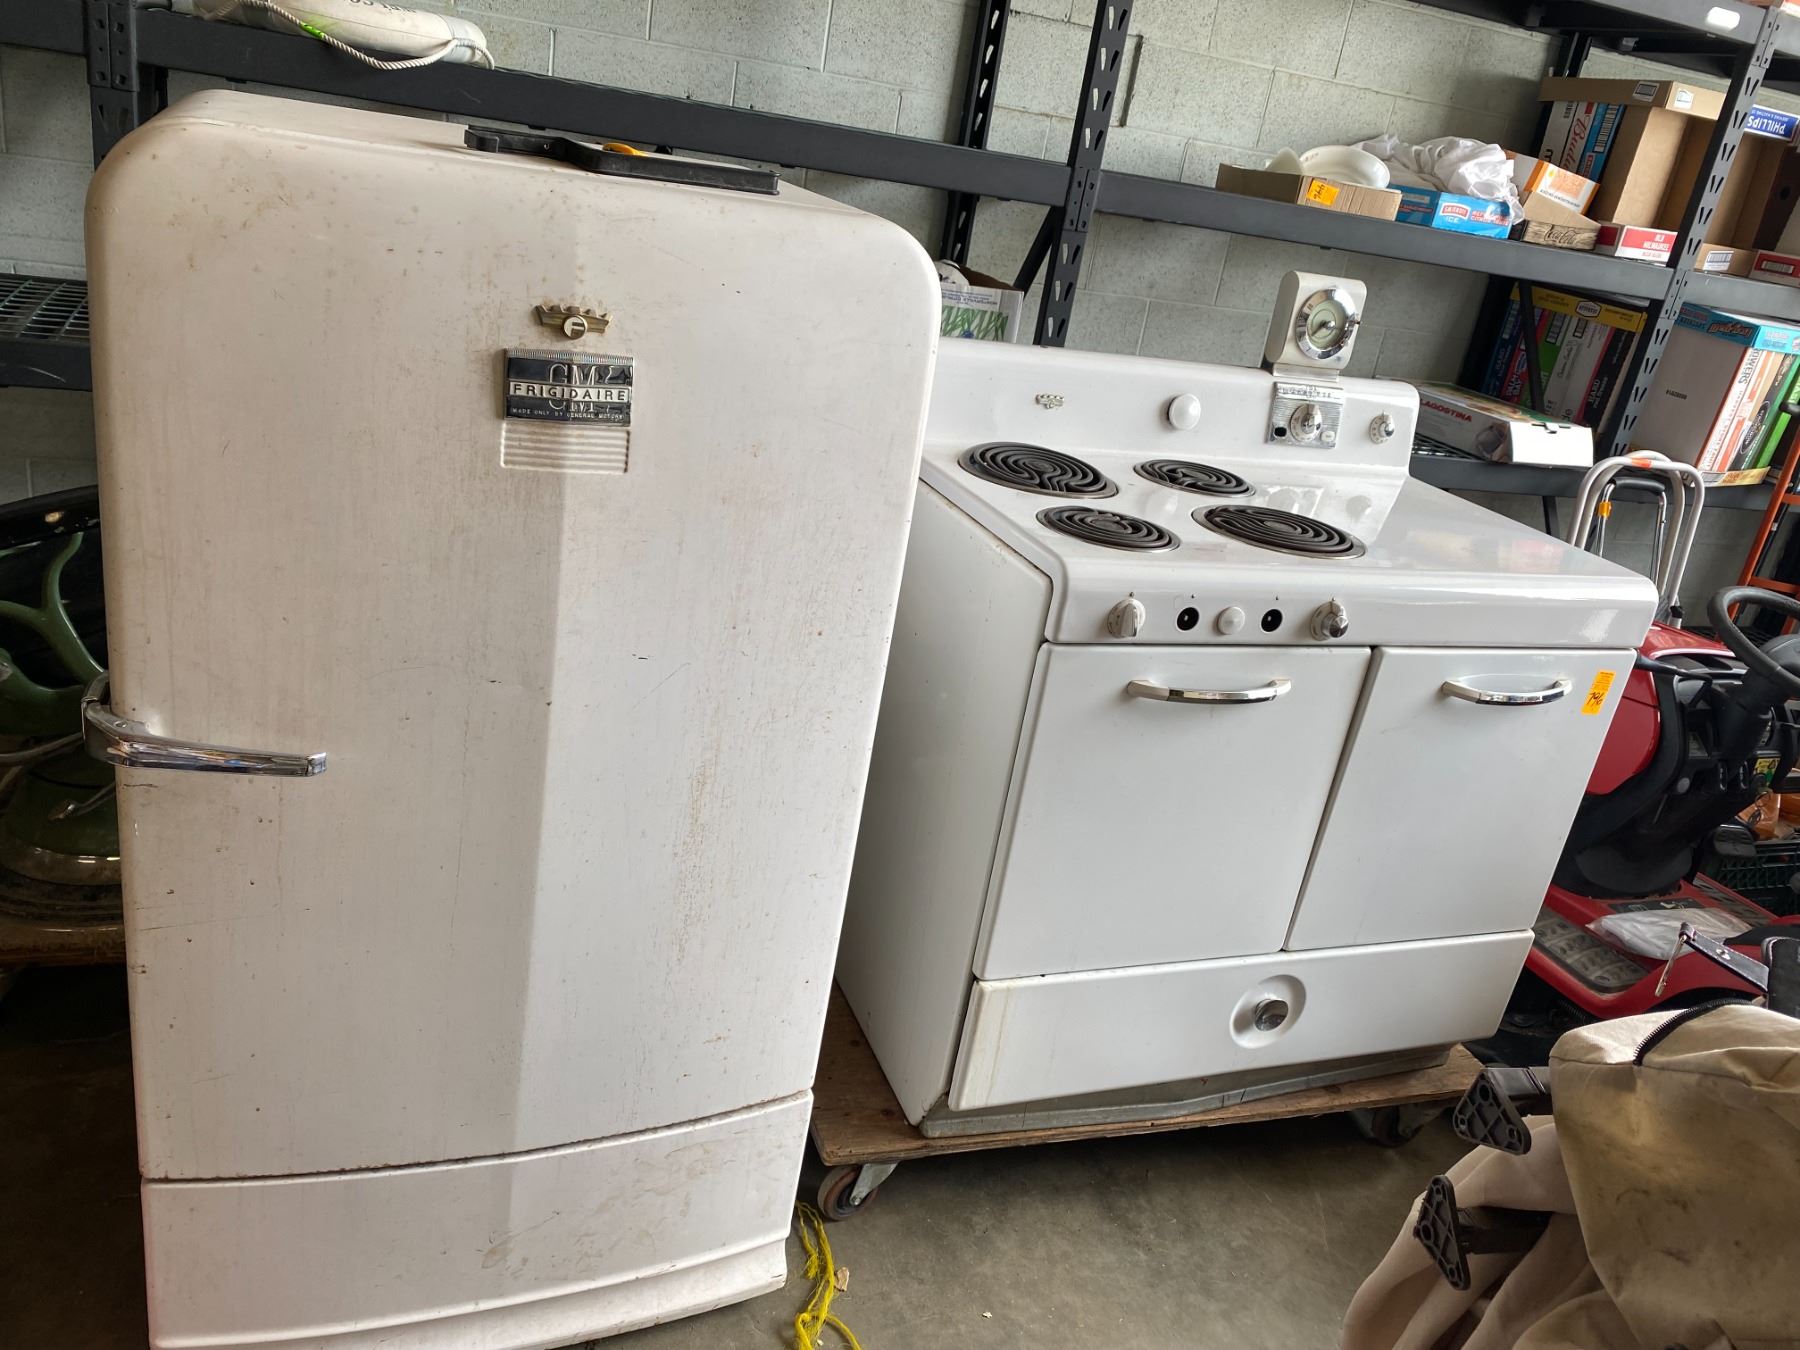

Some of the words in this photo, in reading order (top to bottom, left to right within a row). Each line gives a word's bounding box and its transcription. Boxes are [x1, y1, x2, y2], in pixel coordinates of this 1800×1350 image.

[1747, 116, 1786, 134] PHILLIPS
[513, 385, 626, 401] FRIGIDAIRE
[1588, 379, 1601, 403] HARD
